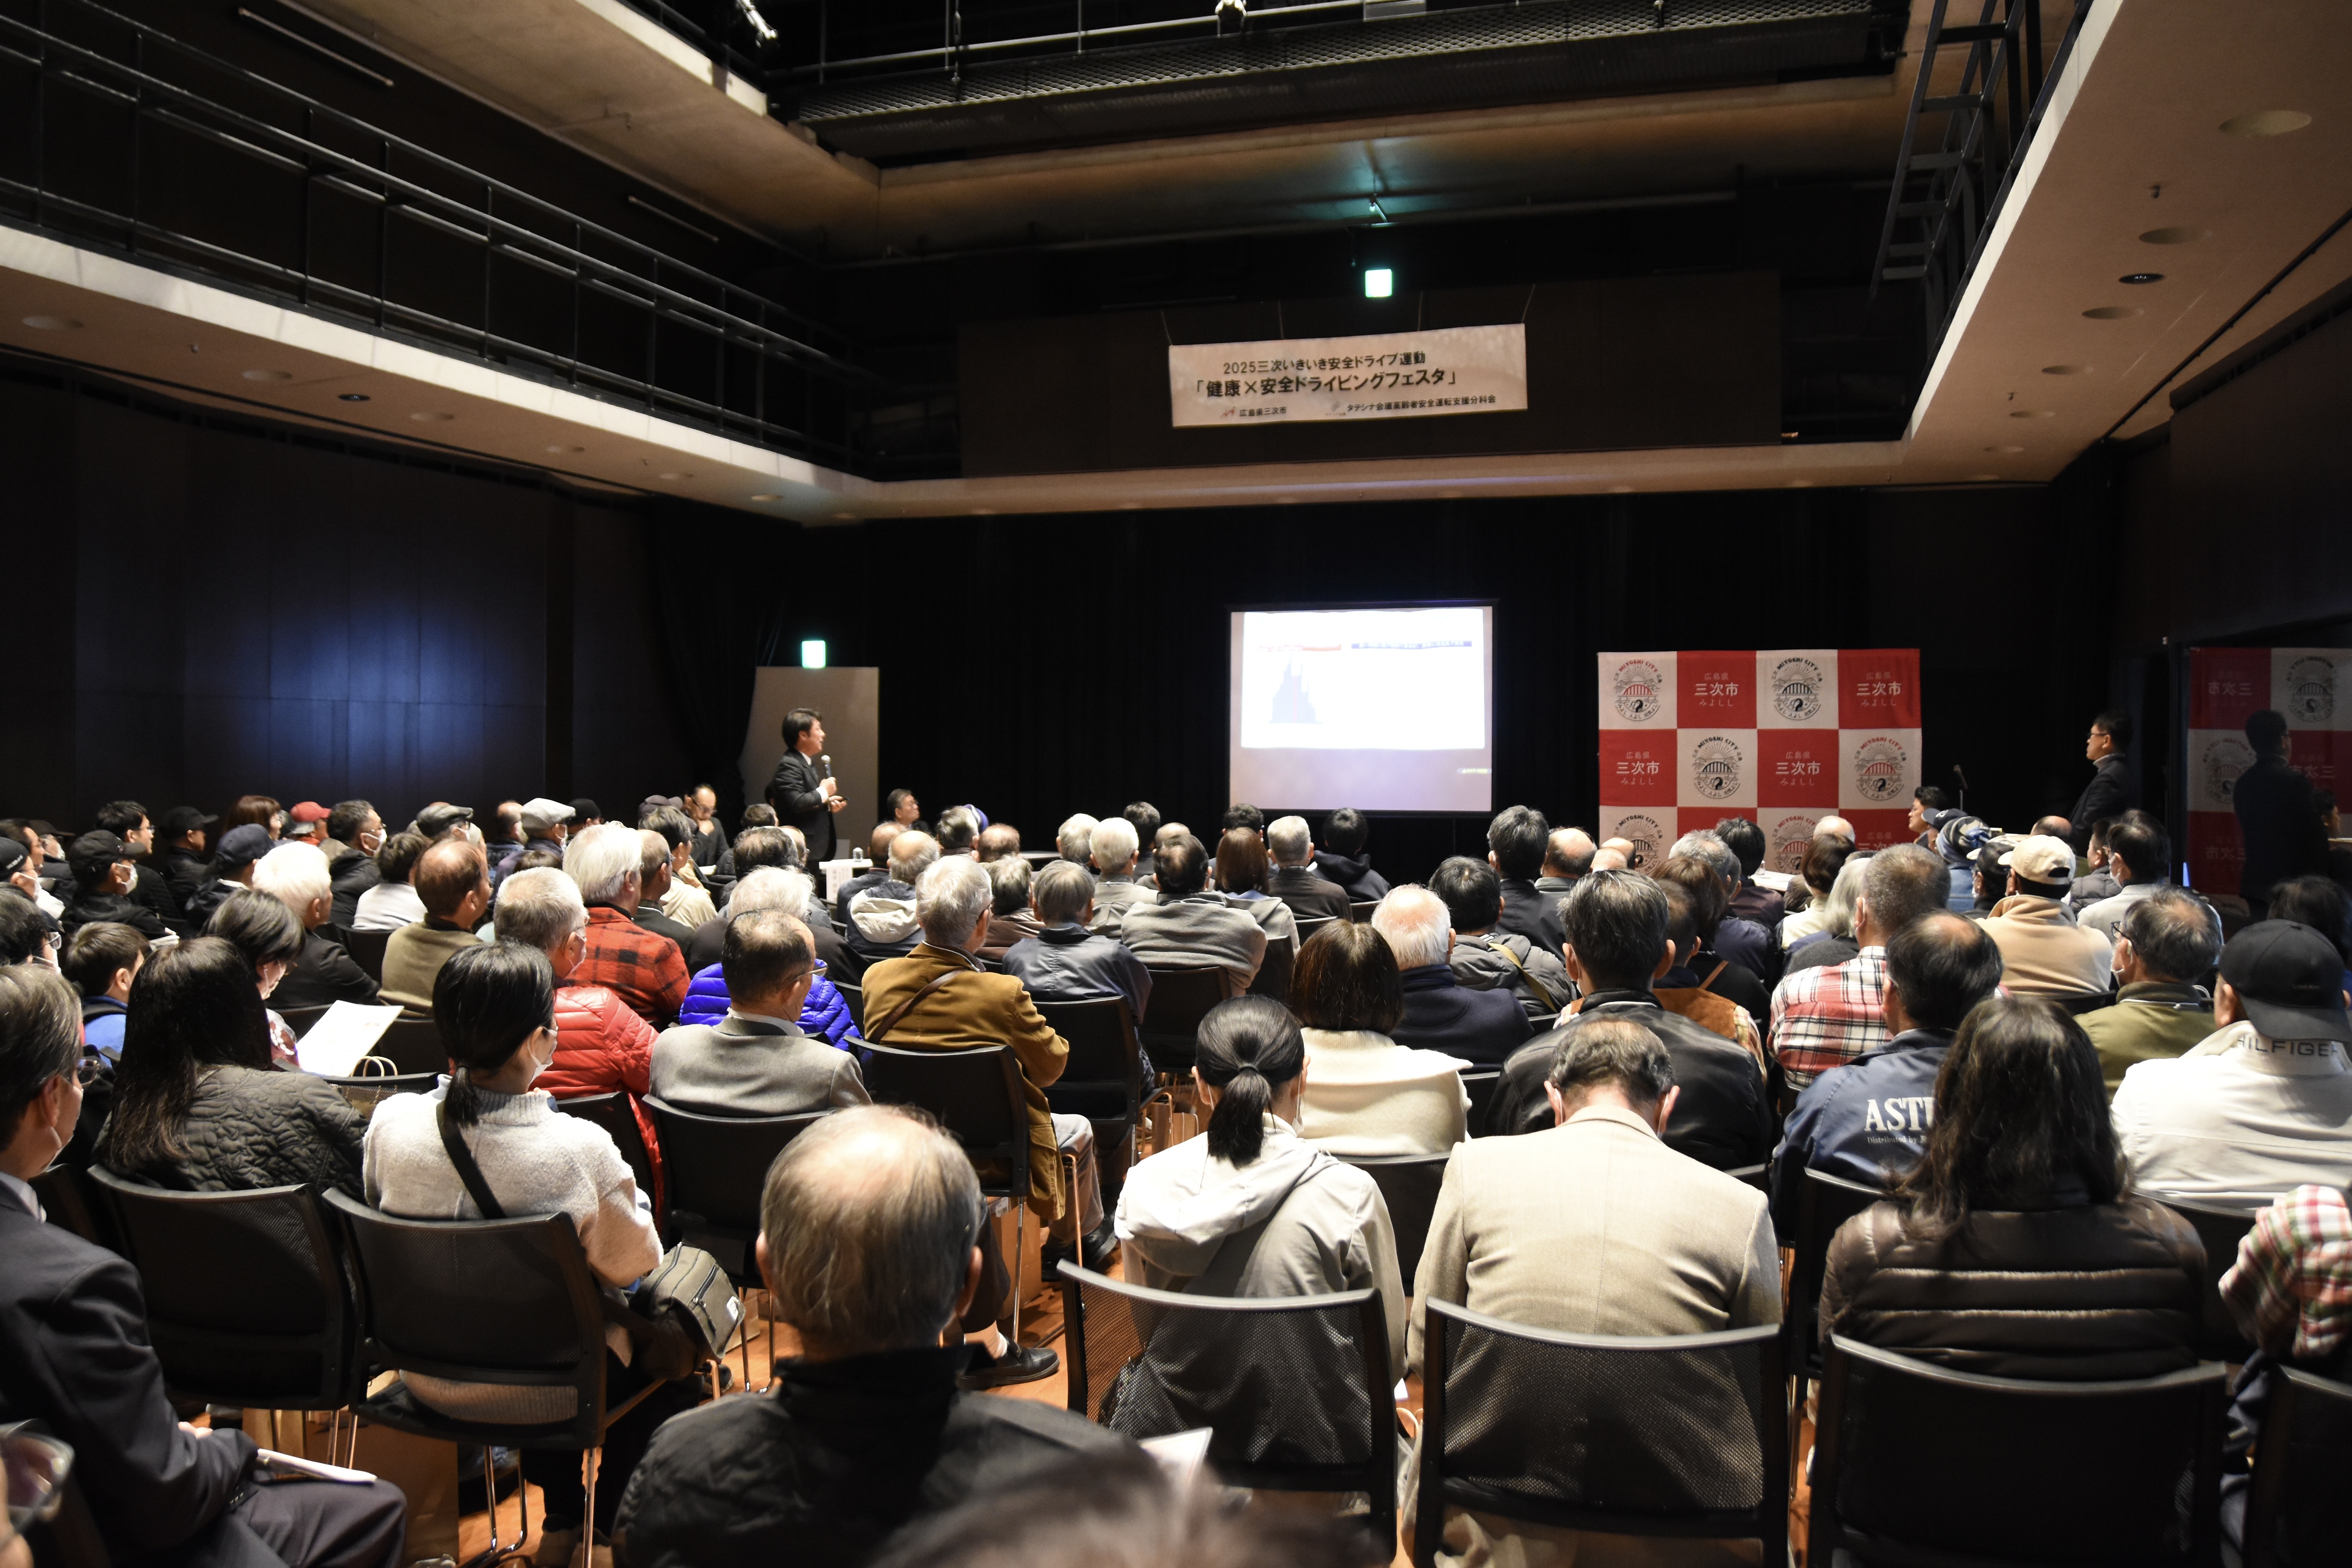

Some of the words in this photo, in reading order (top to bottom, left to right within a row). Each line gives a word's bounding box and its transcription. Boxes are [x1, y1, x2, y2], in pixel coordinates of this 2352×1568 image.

[1223, 351, 1425, 374] 2025三次いきいき安全ドライブ運動
[1239, 406, 1287, 416] 広島県三次市
[1619, 659, 1644, 672] MIYOSHI
[1645, 662, 1658, 673] CITY
[1777, 657, 1803, 670] MIYOSHI
[1805, 659, 1818, 670] CITY
[1695, 682, 1739, 696] 三次市
[1857, 681, 1902, 696] 三次市
[1697, 736, 1723, 748] MIYOSHI
[1725, 738, 1739, 750] CITY
[1860, 737, 1887, 749] MIYOSHI
[1889, 739, 1902, 750] CITY
[1616, 761, 1660, 774] 三次市
[1776, 761, 1821, 775] 三次市
[1619, 814, 1644, 826] MIYOSHI
[1645, 816, 1659, 828] CITY
[1778, 815, 1804, 828] MIYOSHI
[1858, 842, 1898, 851] 三次
